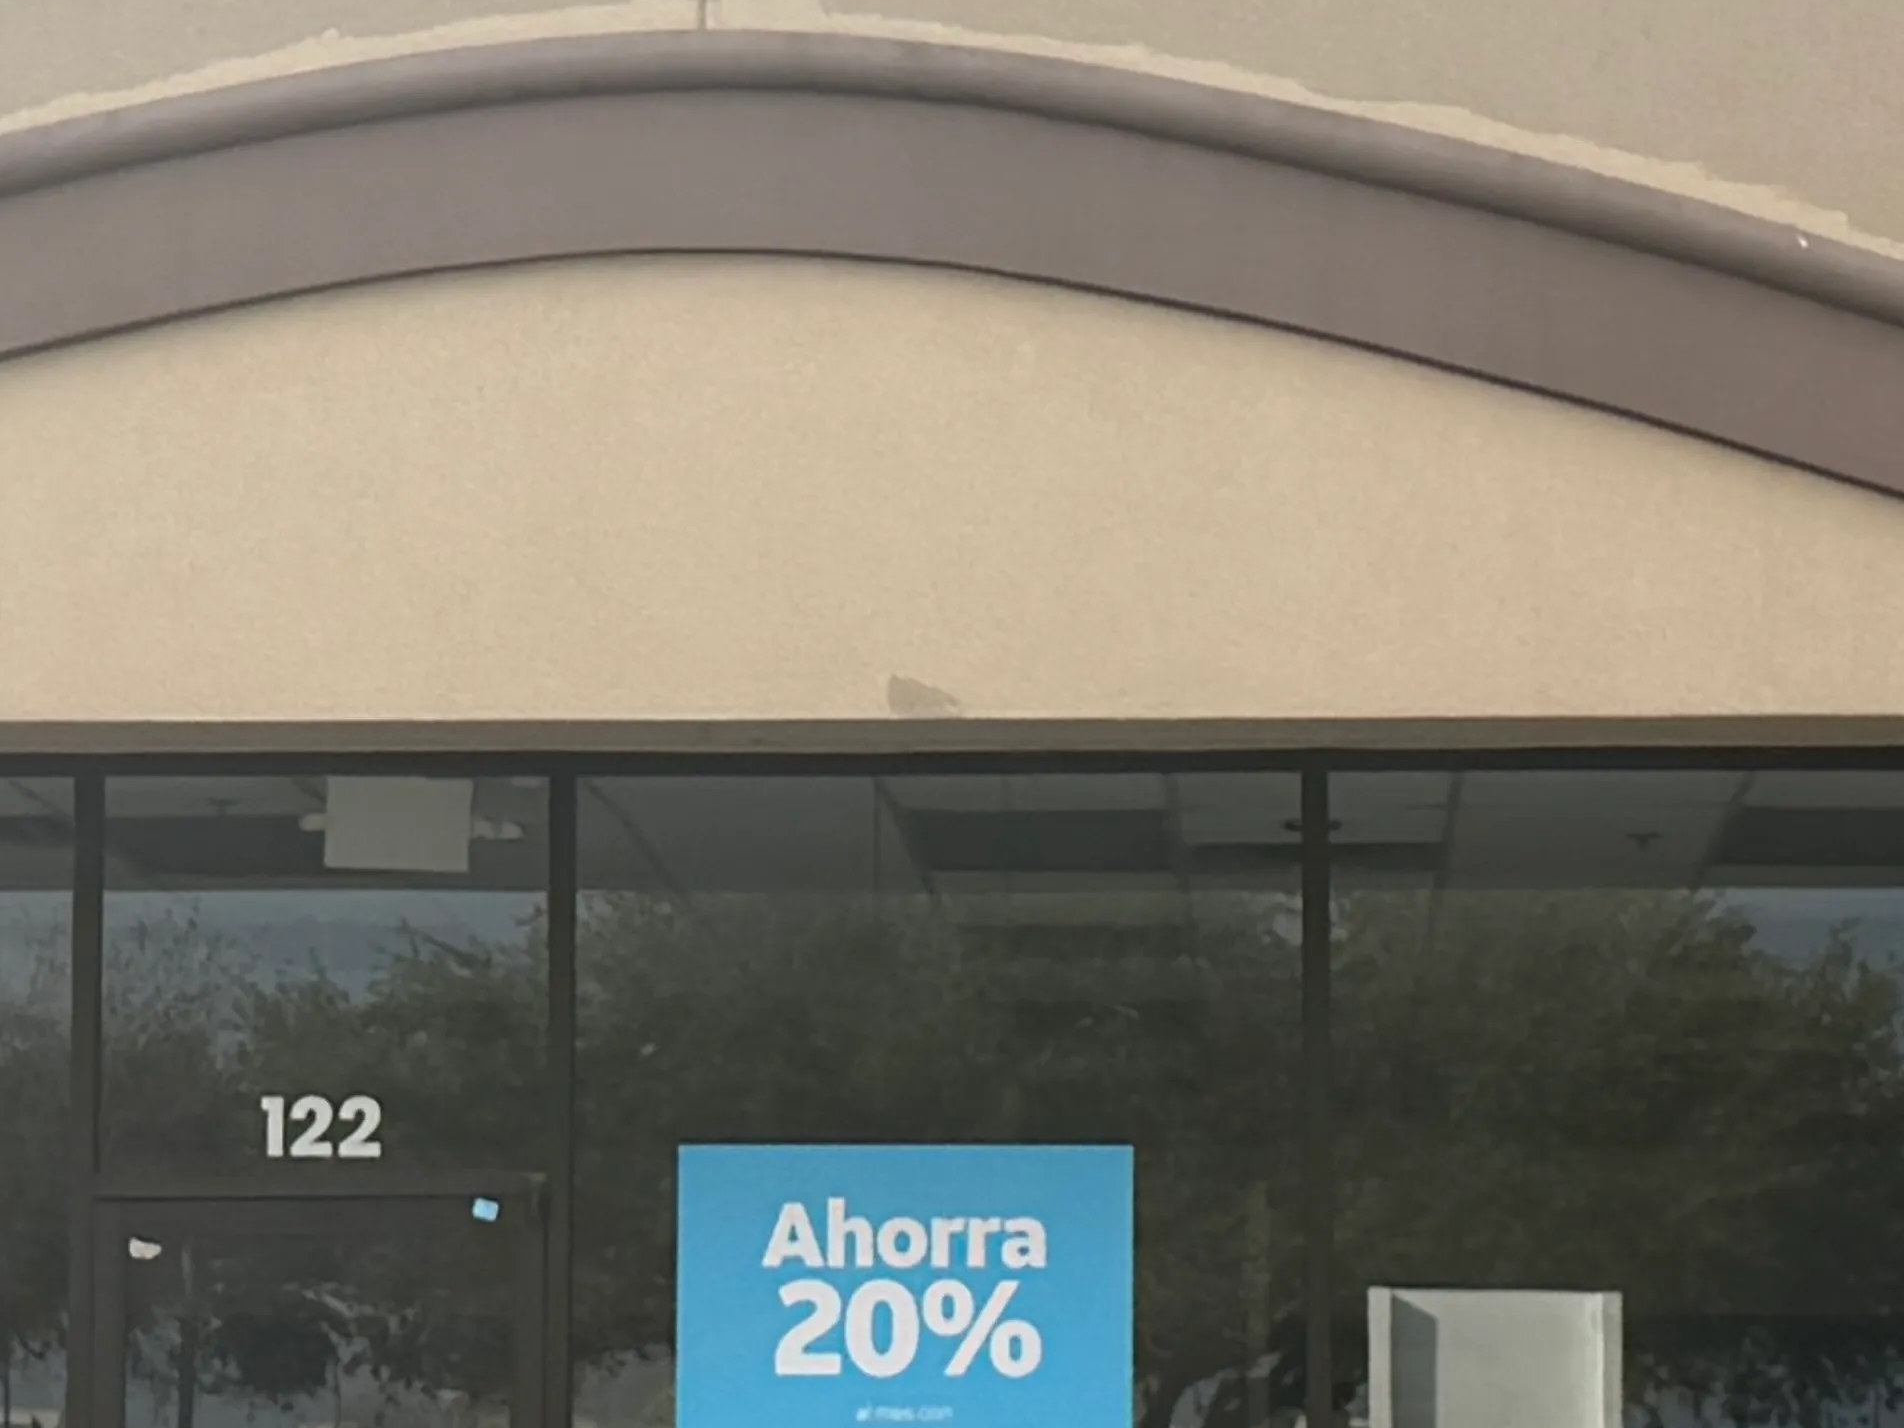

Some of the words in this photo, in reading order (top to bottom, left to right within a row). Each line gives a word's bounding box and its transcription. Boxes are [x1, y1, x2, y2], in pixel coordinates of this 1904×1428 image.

[260, 1094, 382, 1159] 122
[762, 1198, 1046, 1269] Ahorra
[775, 1278, 1042, 1379] 20%
